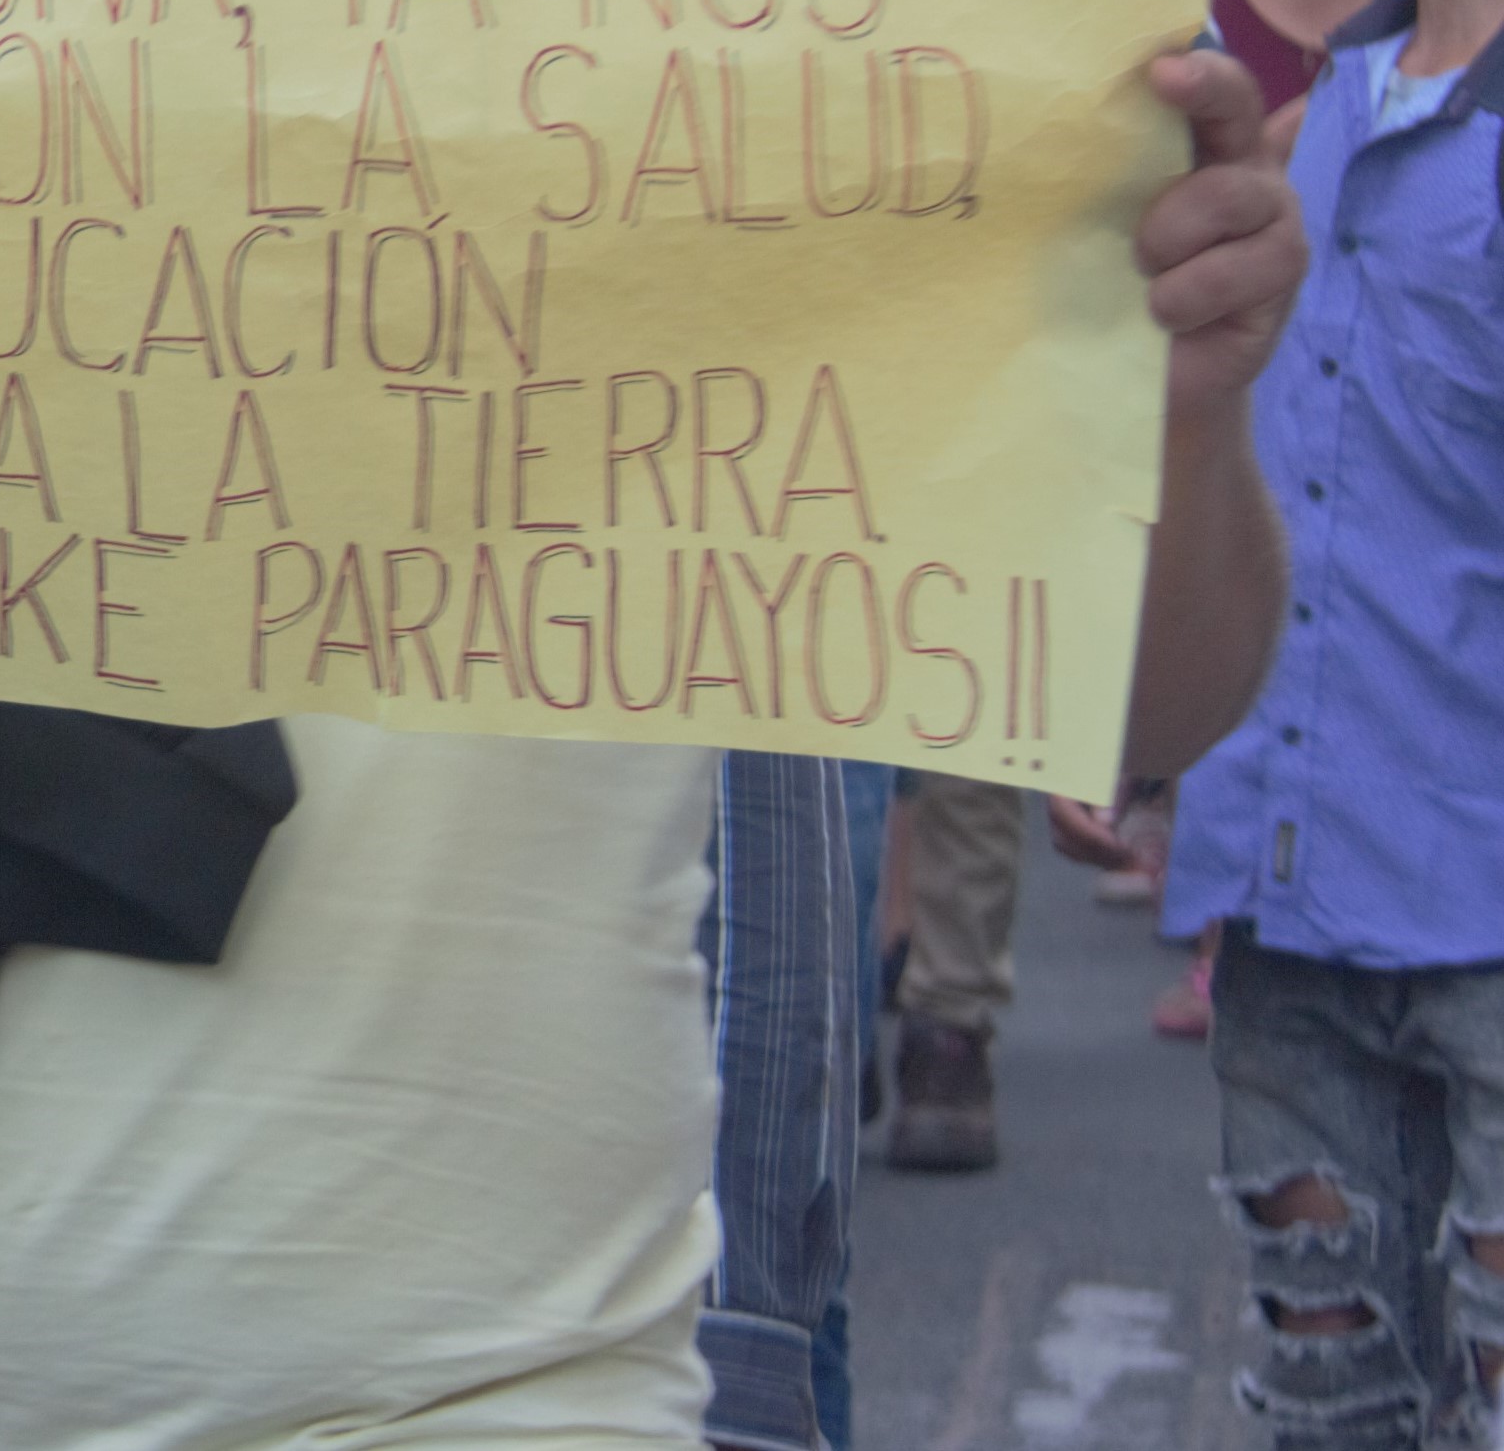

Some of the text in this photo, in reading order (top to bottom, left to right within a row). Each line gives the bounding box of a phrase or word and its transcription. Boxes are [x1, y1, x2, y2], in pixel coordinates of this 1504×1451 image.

[245, 39, 440, 217] LA
[519, 44, 989, 227] SALUD,
[118, 389, 292, 542] LA
[249, 539, 1050, 773] PARAGUAYOS!!
